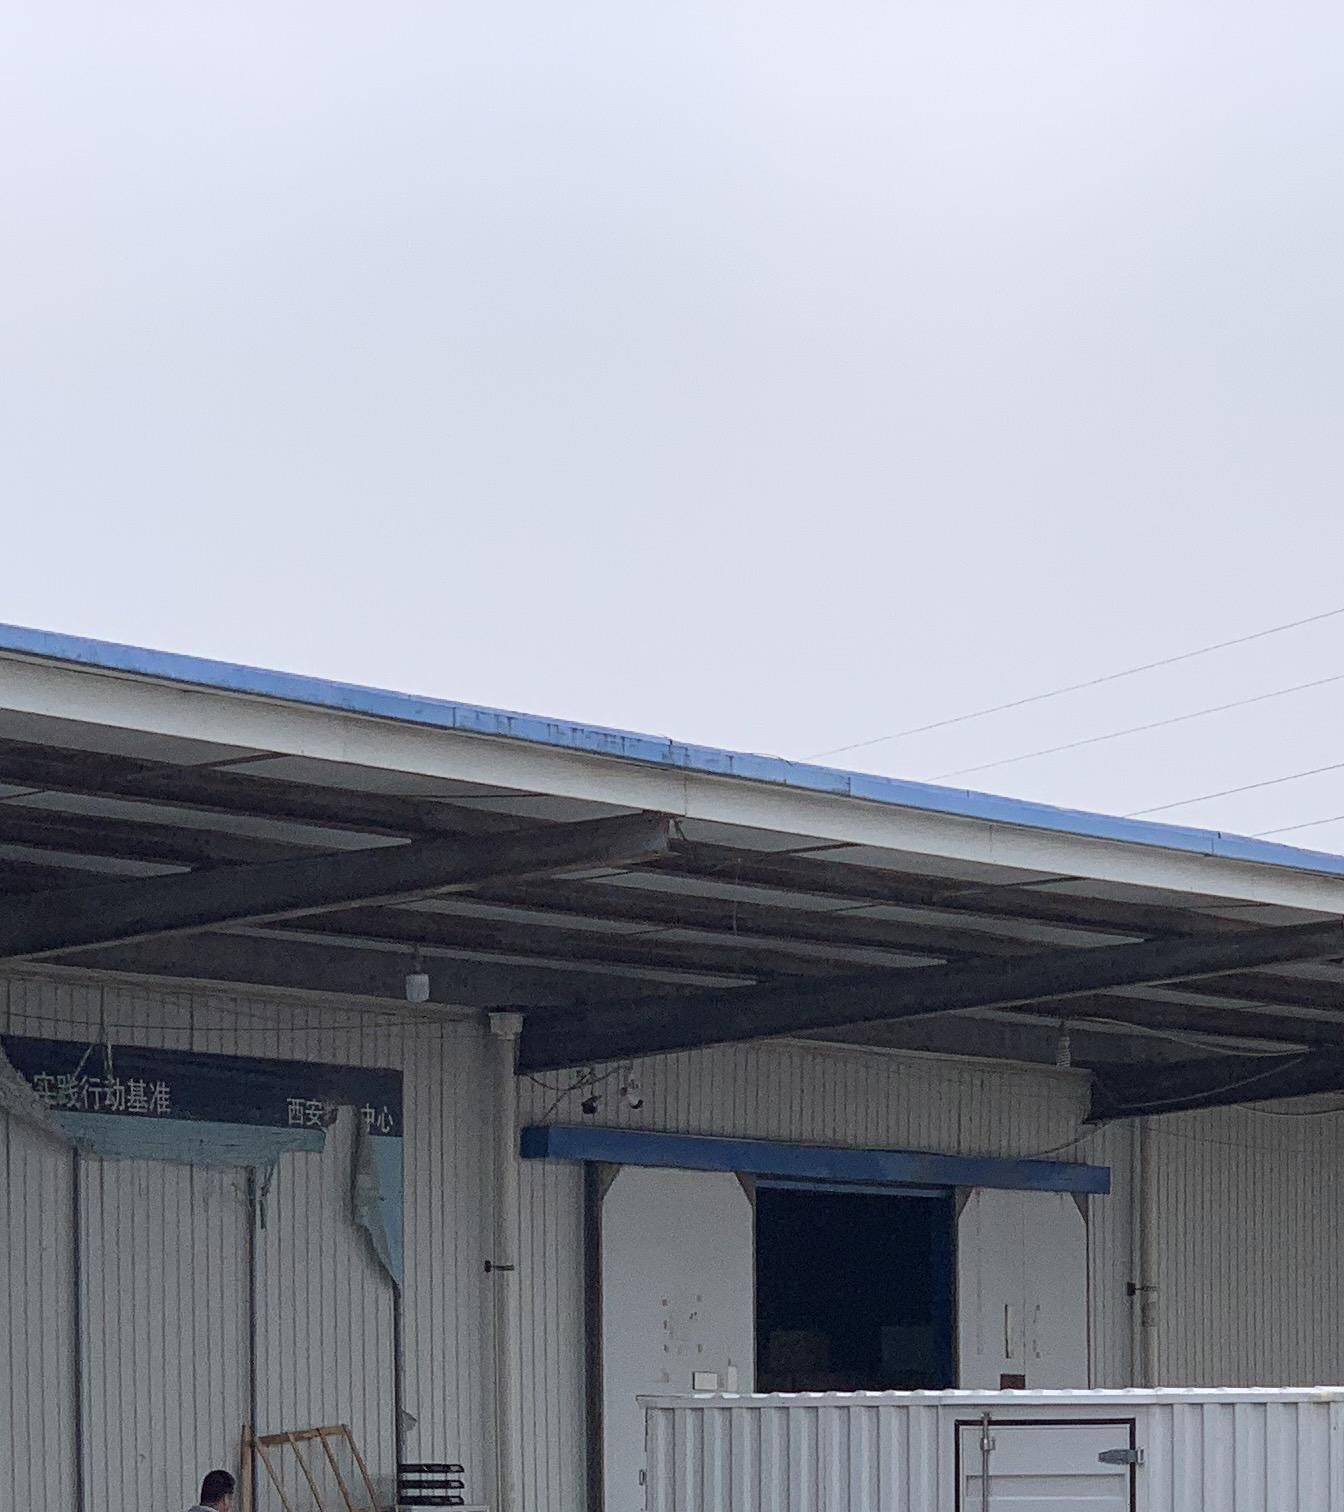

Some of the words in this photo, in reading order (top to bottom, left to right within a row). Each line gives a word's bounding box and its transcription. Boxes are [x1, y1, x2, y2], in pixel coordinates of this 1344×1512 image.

[33, 1071, 171, 1114] 实践行动基准
